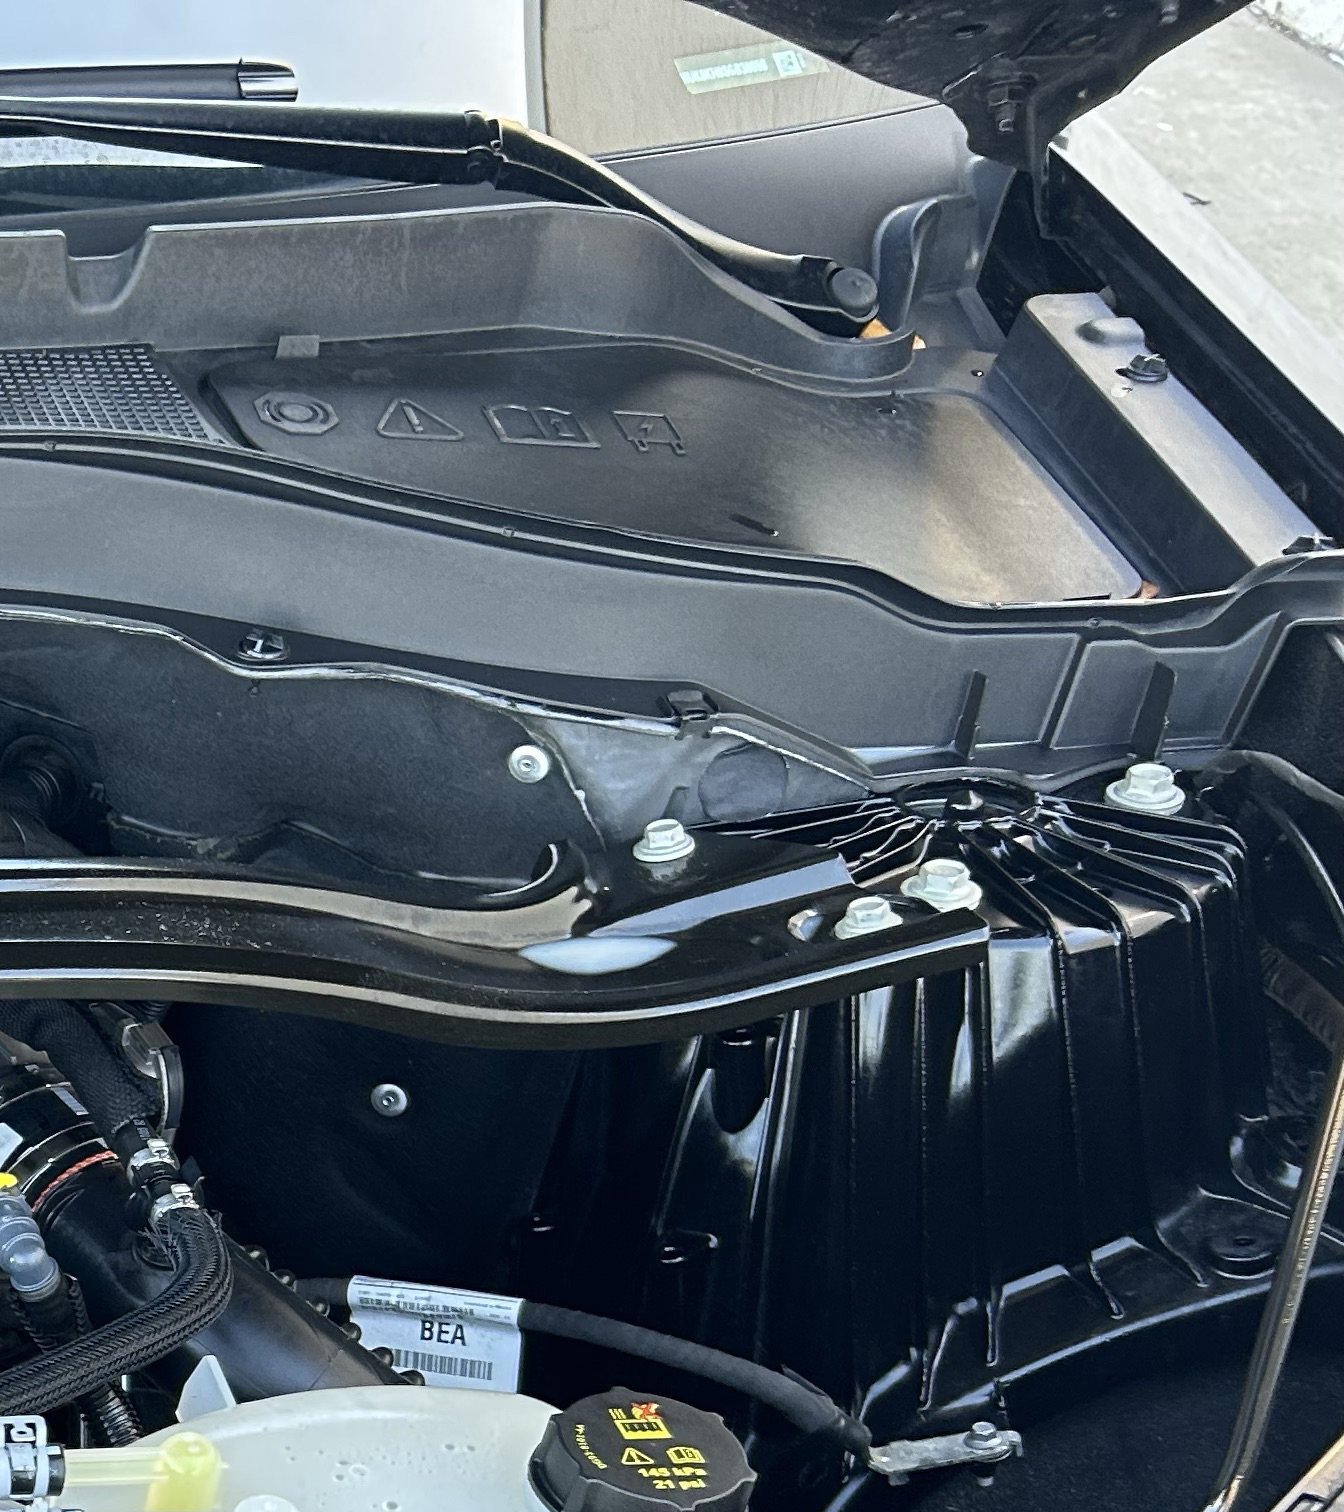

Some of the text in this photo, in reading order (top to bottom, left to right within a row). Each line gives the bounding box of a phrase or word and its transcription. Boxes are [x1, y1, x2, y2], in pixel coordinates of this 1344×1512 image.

[420, 1320, 467, 1346] BEA
[637, 1466, 708, 1478] 145 kPa
[652, 1478, 708, 1490] 21 psi
